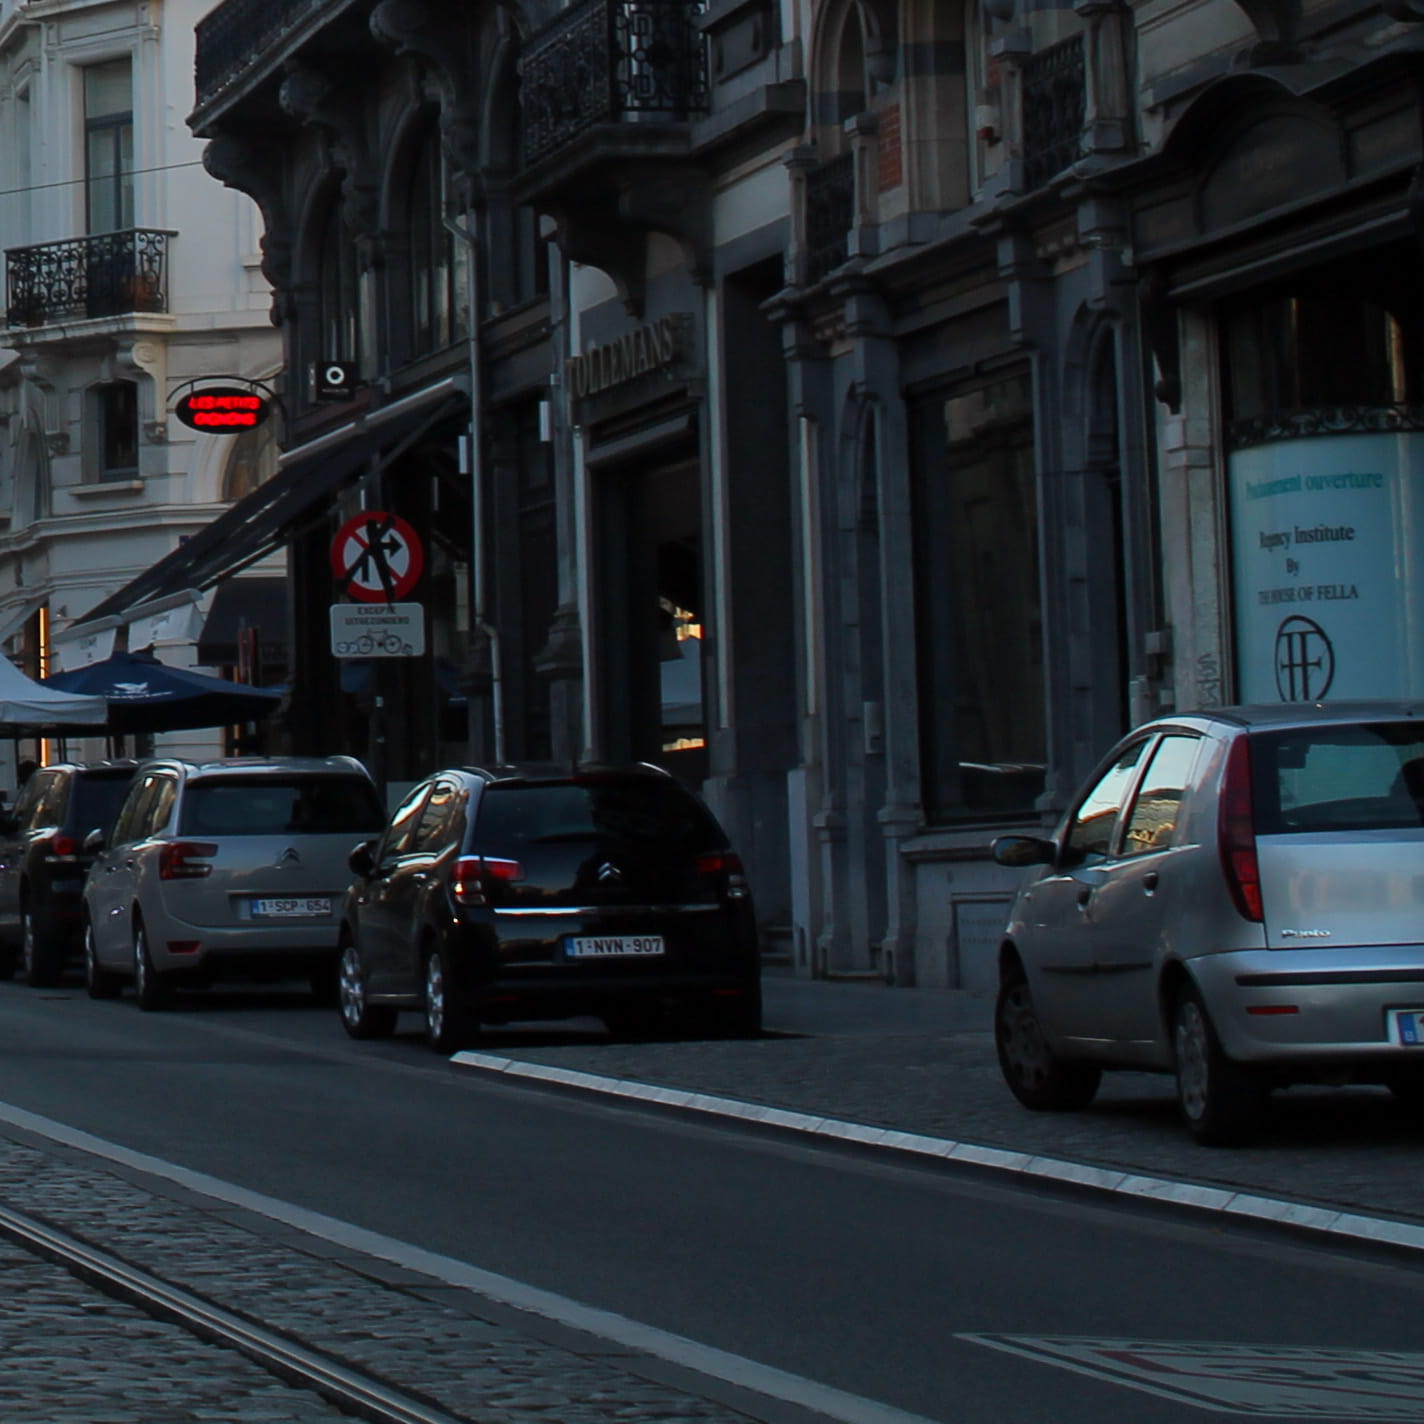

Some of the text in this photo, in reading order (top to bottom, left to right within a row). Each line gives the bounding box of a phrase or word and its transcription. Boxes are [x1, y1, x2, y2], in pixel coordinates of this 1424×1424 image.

[1305, 472, 1384, 492] ouverture
[1294, 524, 1355, 545] Institute
[1298, 586, 1314, 602] OF
[1317, 583, 1359, 600] FELLA
[1281, 928, 1331, 938] Punto
